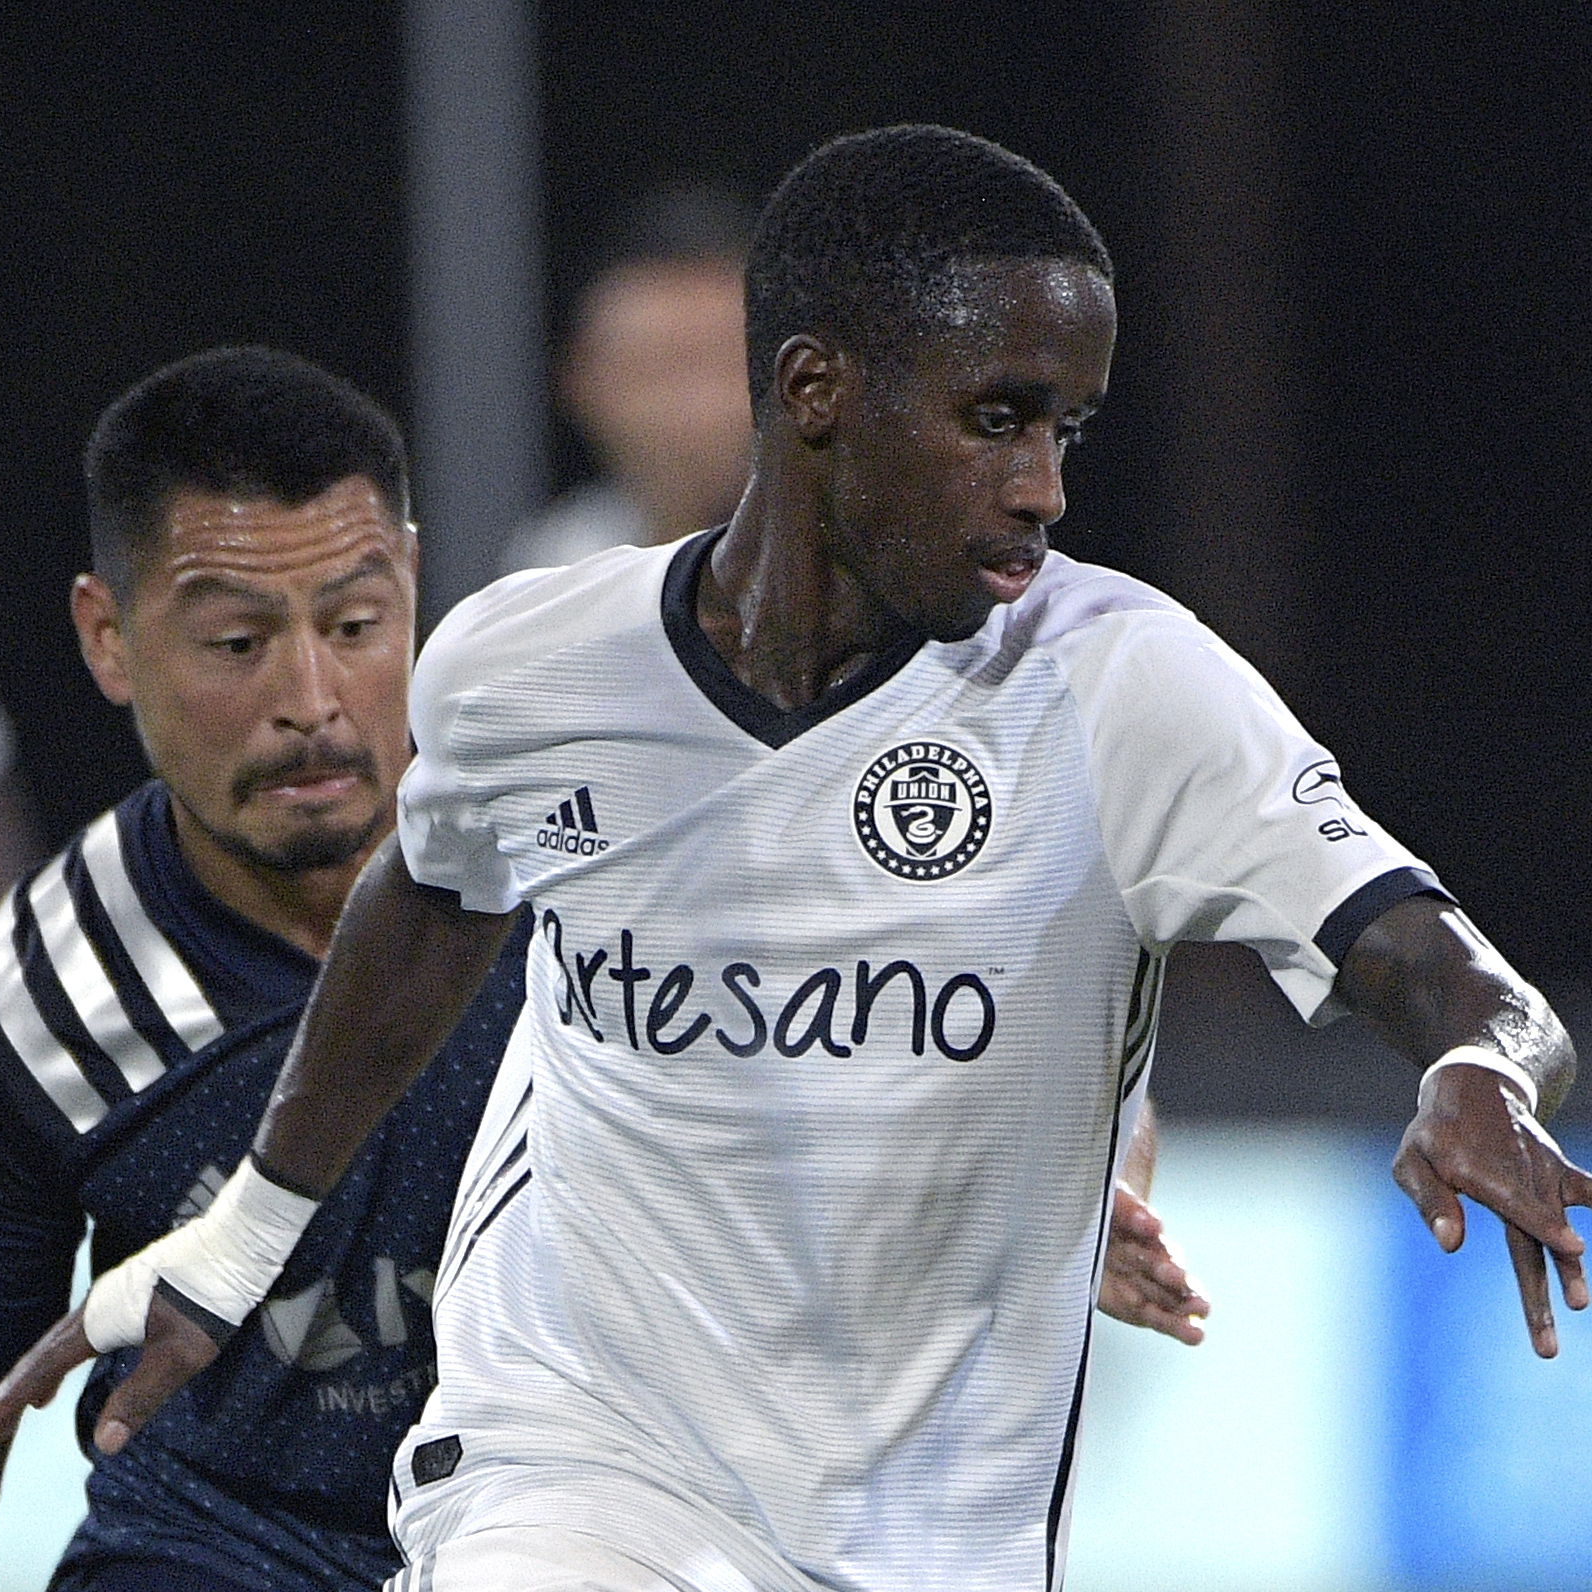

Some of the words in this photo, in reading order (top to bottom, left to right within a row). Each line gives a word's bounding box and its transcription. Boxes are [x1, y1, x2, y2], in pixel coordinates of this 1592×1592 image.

[857, 744, 989, 810] PHILADELPHIA
[897, 781, 950, 801] UNION
[536, 825, 610, 857] adidas
